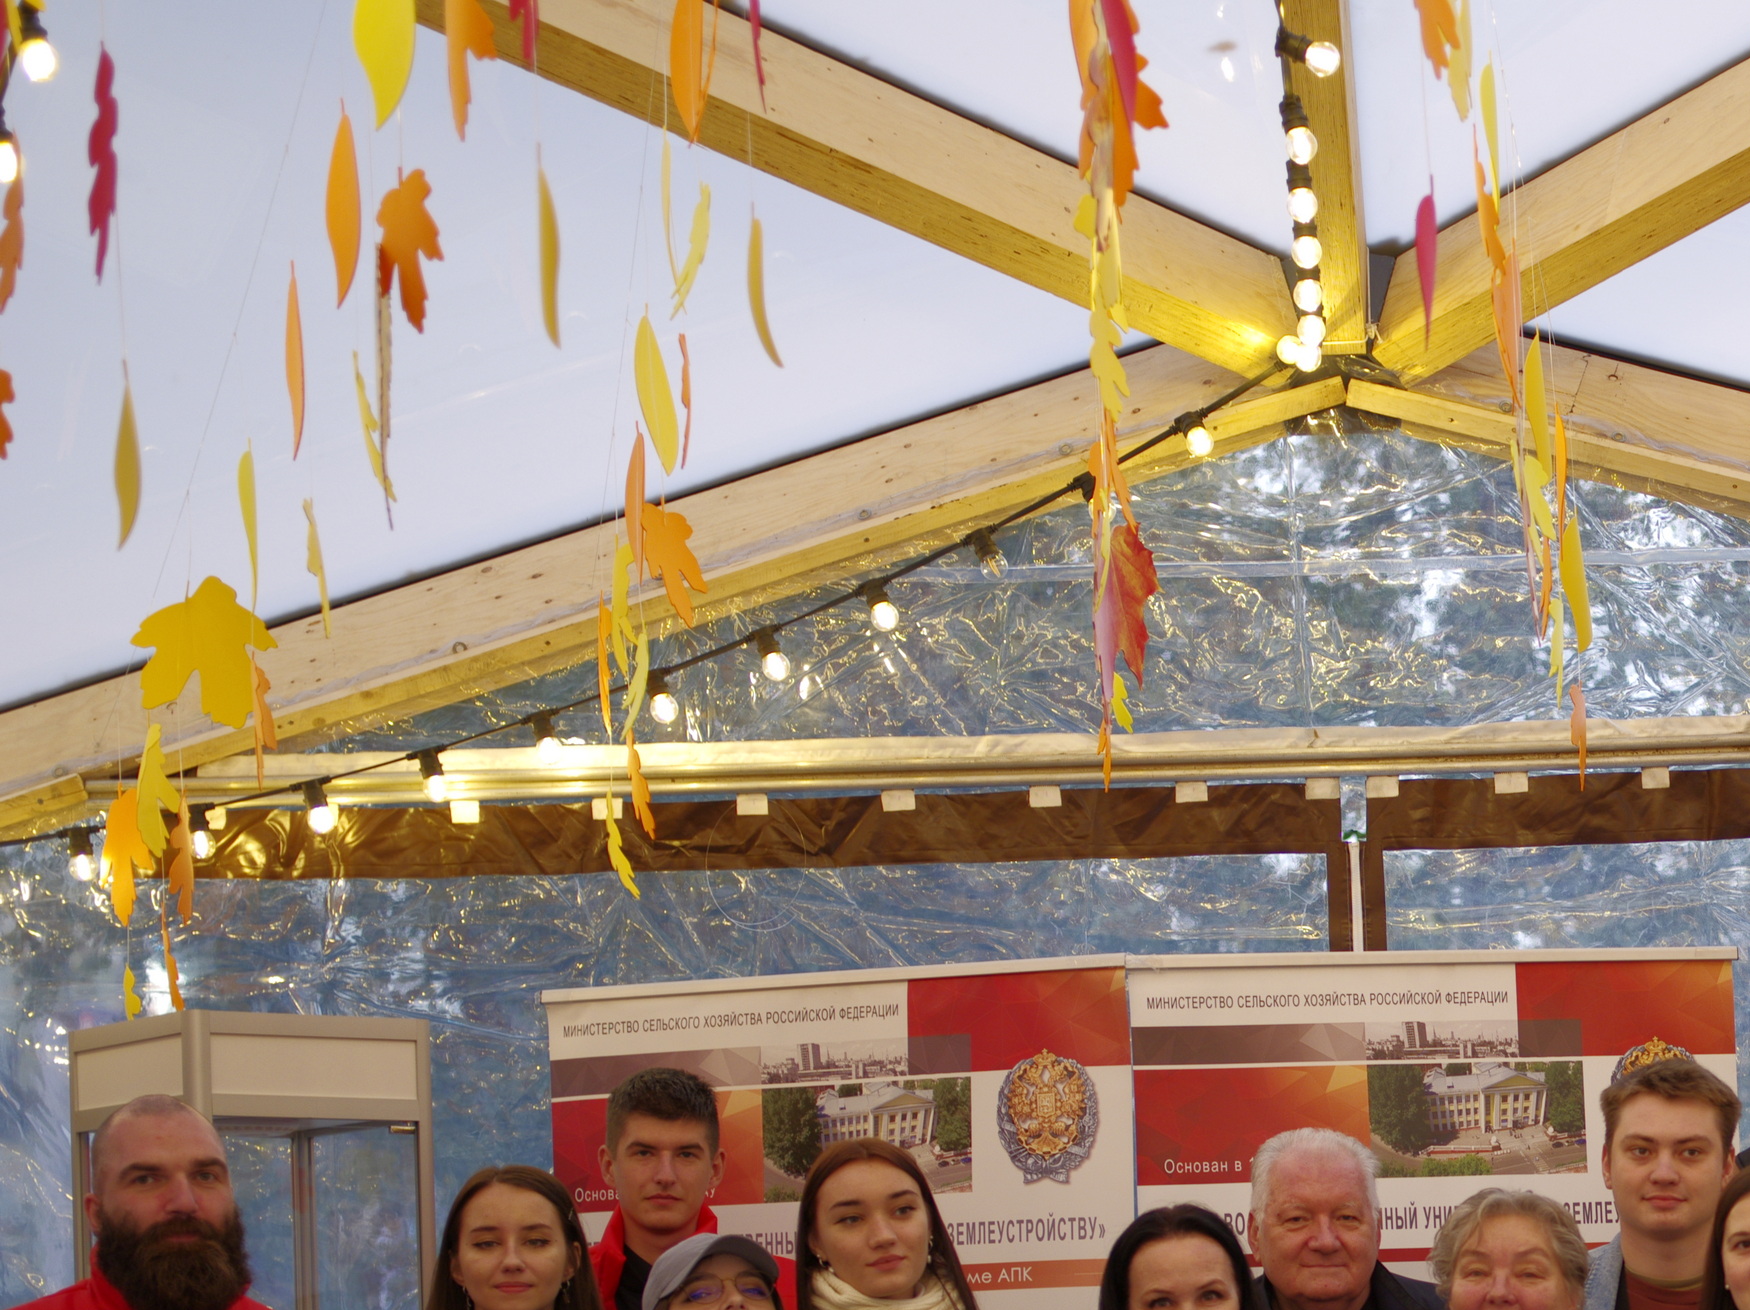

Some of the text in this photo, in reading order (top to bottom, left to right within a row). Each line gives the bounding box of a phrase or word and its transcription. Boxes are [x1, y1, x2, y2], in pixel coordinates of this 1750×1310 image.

[1146, 989, 1509, 1010] МИНИСТЕРСТВО СЕЛЬСКОГО ХОЗЯЙСТВА РОССИЙСКОЙ ФЕДЕРАЦИИ
[563, 1003, 899, 1038] МИНИСТЕРСТВО СЕЛЬСКОГО ХОЗЯЙСТВА РОССИЙСКОЙ ФЕДЕРАЦИИ
[1164, 1158, 1242, 1174] Основан в
[947, 1212, 1106, 1246] ЗЕМЛЕУСТРОЙСТВУ»
[997, 1266, 1033, 1284] АПК
